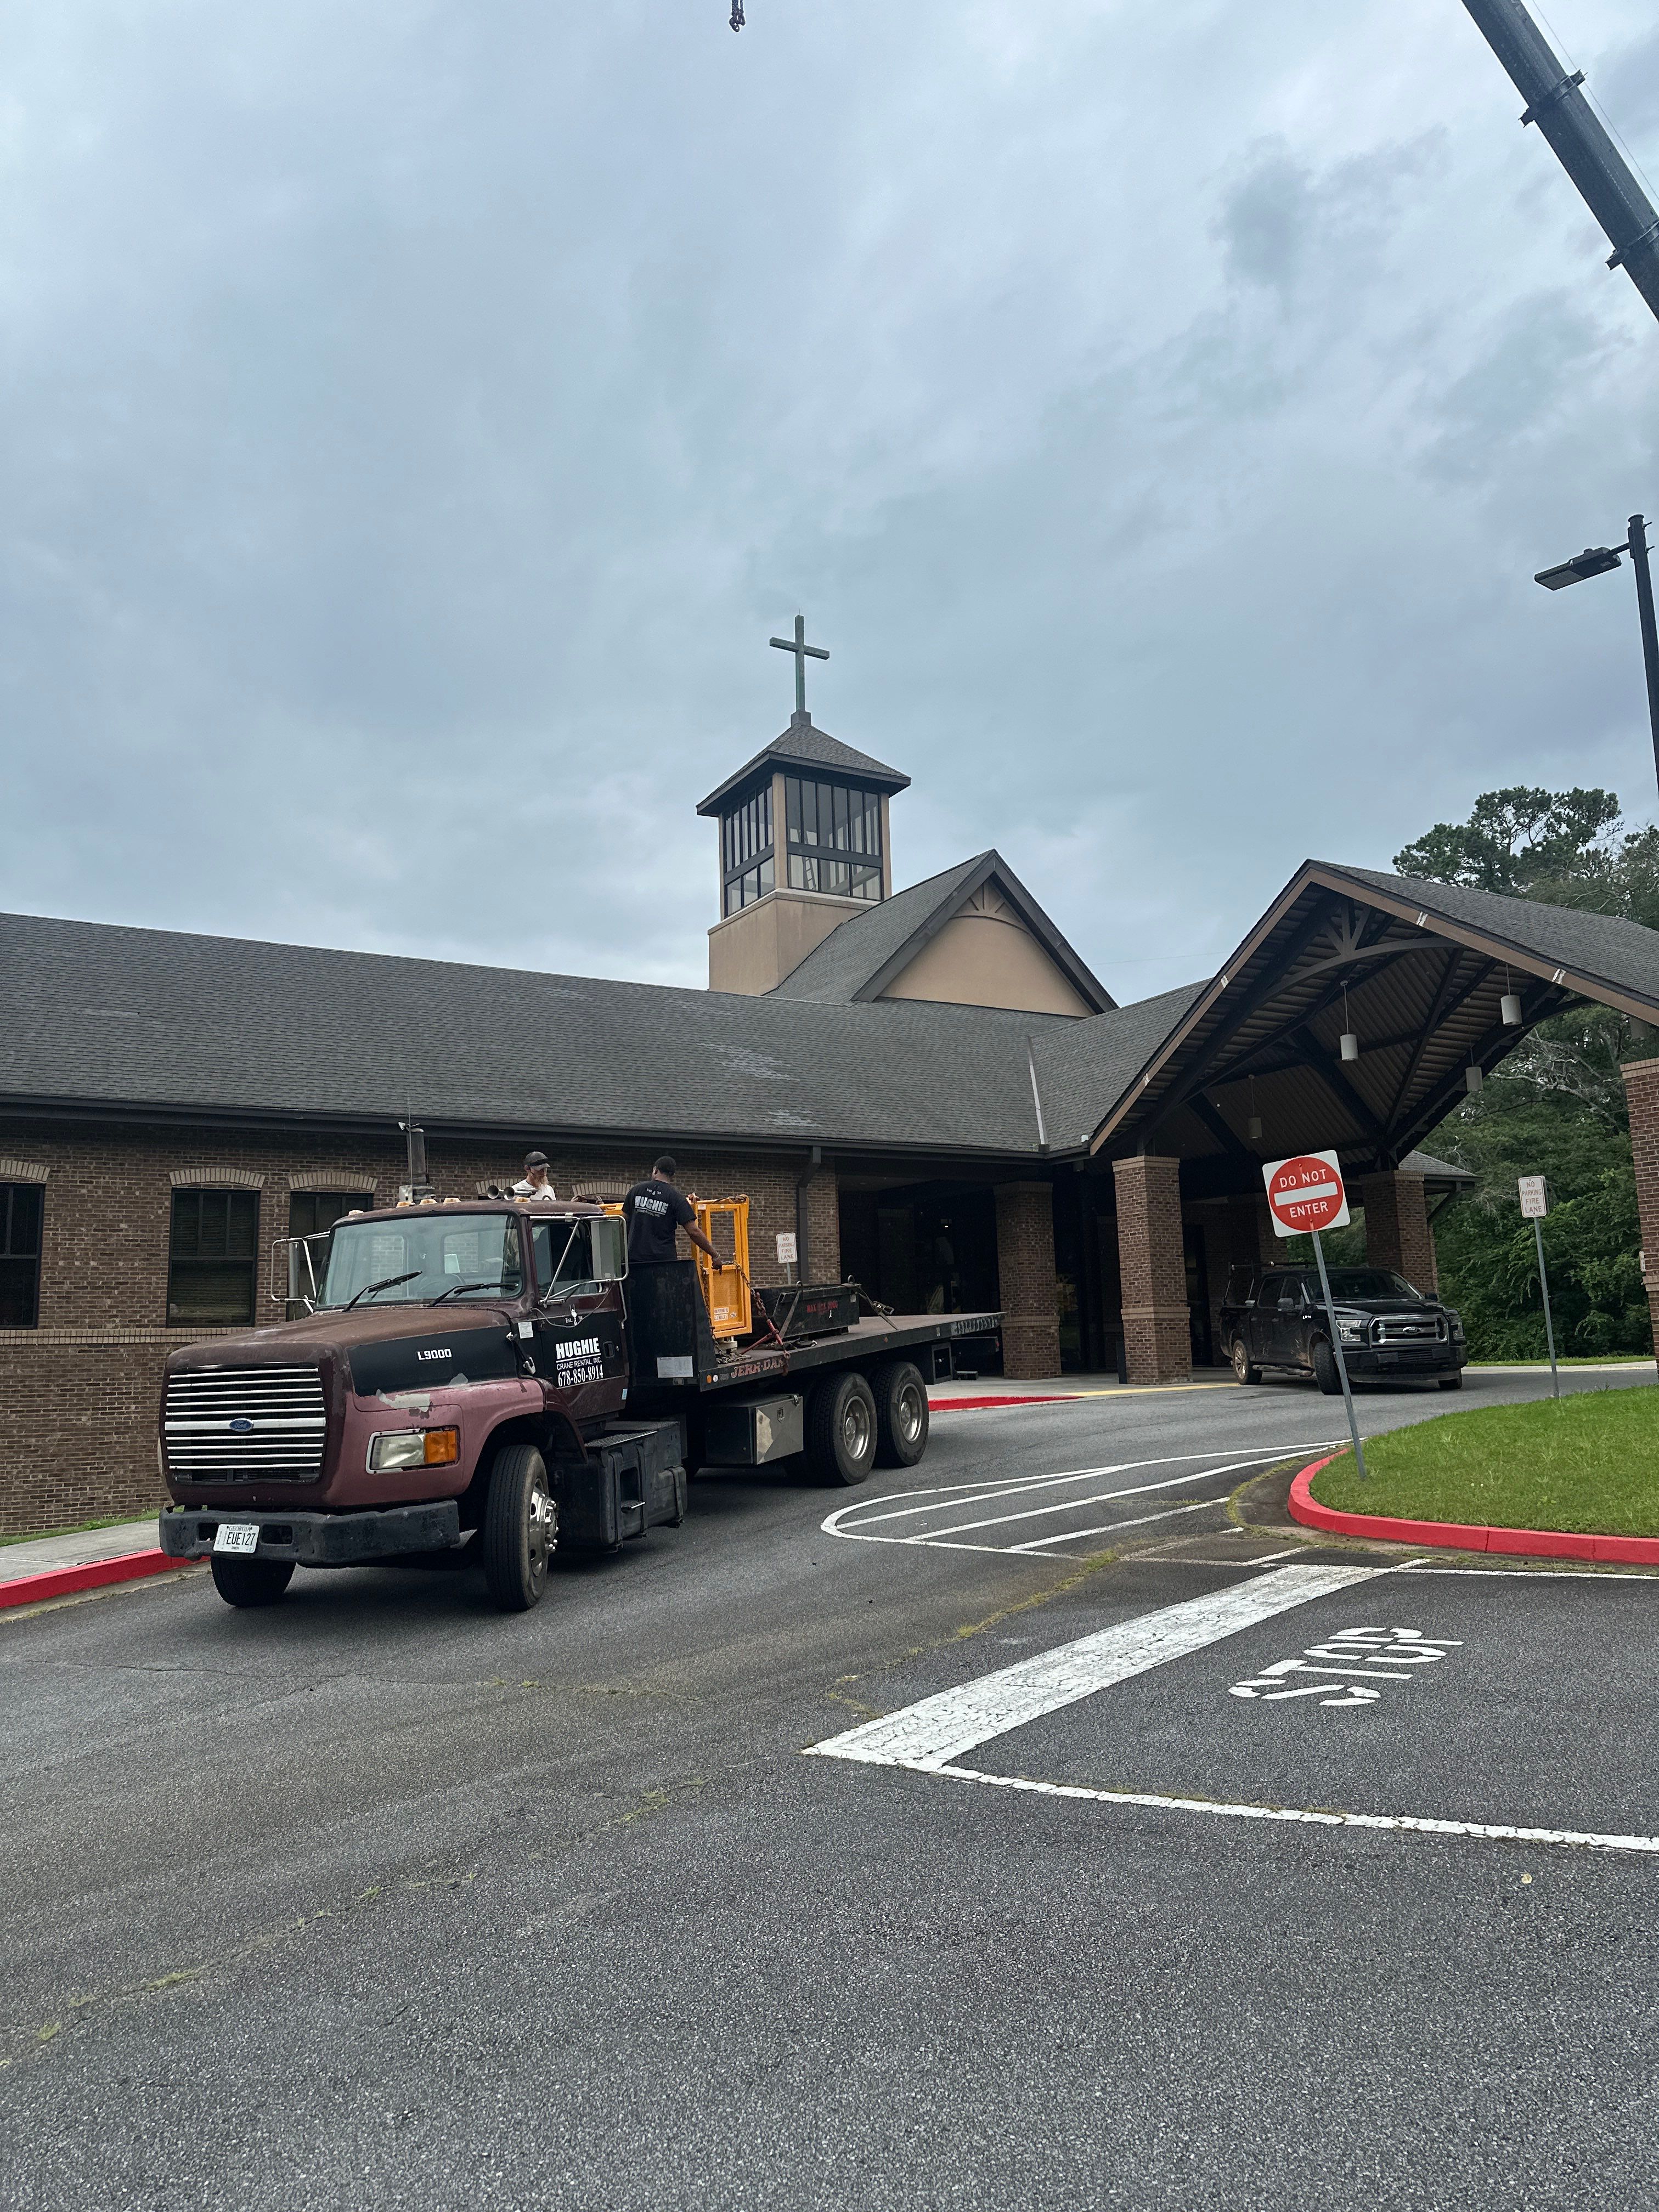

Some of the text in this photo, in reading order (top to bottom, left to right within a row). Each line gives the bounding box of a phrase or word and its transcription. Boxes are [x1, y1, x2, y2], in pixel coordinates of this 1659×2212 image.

[1279, 1169, 1326, 1188] DO NOT
[635, 1195, 669, 1214] HUGHIE
[1289, 1201, 1329, 1218] ENTER
[417, 1348, 452, 1360] L9000
[555, 1337, 600, 1359] HUGHIE
[556, 1361, 574, 1371] CRANE
[558, 1364, 603, 1387] 678-850-8914
[226, 1532, 256, 1546] EUE127
[1228, 1627, 1464, 1706] STOP
